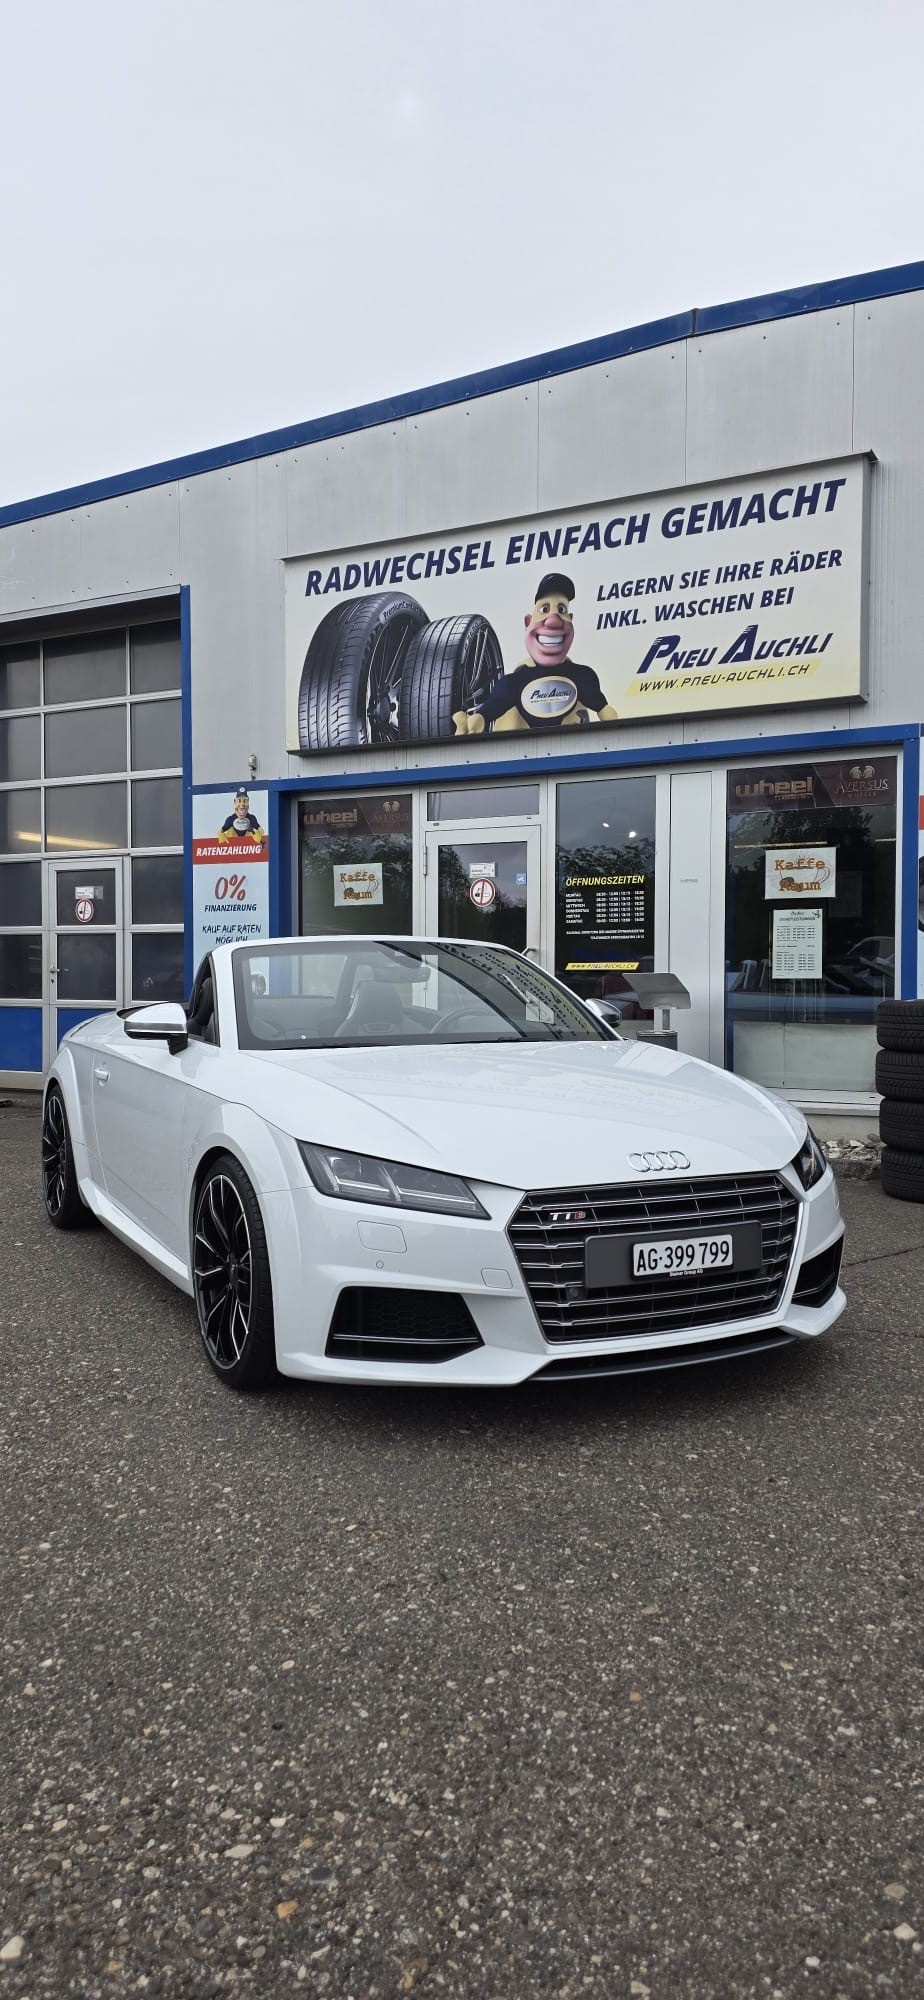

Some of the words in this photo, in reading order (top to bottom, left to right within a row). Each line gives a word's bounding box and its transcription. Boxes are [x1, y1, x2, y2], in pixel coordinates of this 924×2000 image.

[305, 541, 495, 596] RADWECHSEL
[505, 513, 650, 565] EINFACH
[661, 478, 847, 538] GEMACHT
[597, 574, 674, 601] LAGERN
[679, 569, 711, 589] SIE
[714, 561, 765, 584] IHRE
[769, 549, 843, 576] RÄDER
[597, 608, 647, 630] INKL.
[655, 592, 754, 622] WASCHEN
[760, 587, 795, 608] BEI
[735, 776, 813, 797] wheel
[304, 808, 358, 824] wheel
[196, 844, 262, 857] RATENZAHLUNG
[774, 858, 826, 871] Kaffe
[339, 871, 376, 883] Kaffe
[565, 875, 645, 887] ÖFFNUNGSZEITEN
[214, 874, 247, 901] 0%
[779, 880, 821, 892] Raum
[204, 903, 257, 912] FINANZIERUNG
[202, 924, 222, 934] KAUF
[222, 924, 237, 934] AUF
[237, 924, 262, 934] RATEN
[699, 1240, 730, 1265] 799
